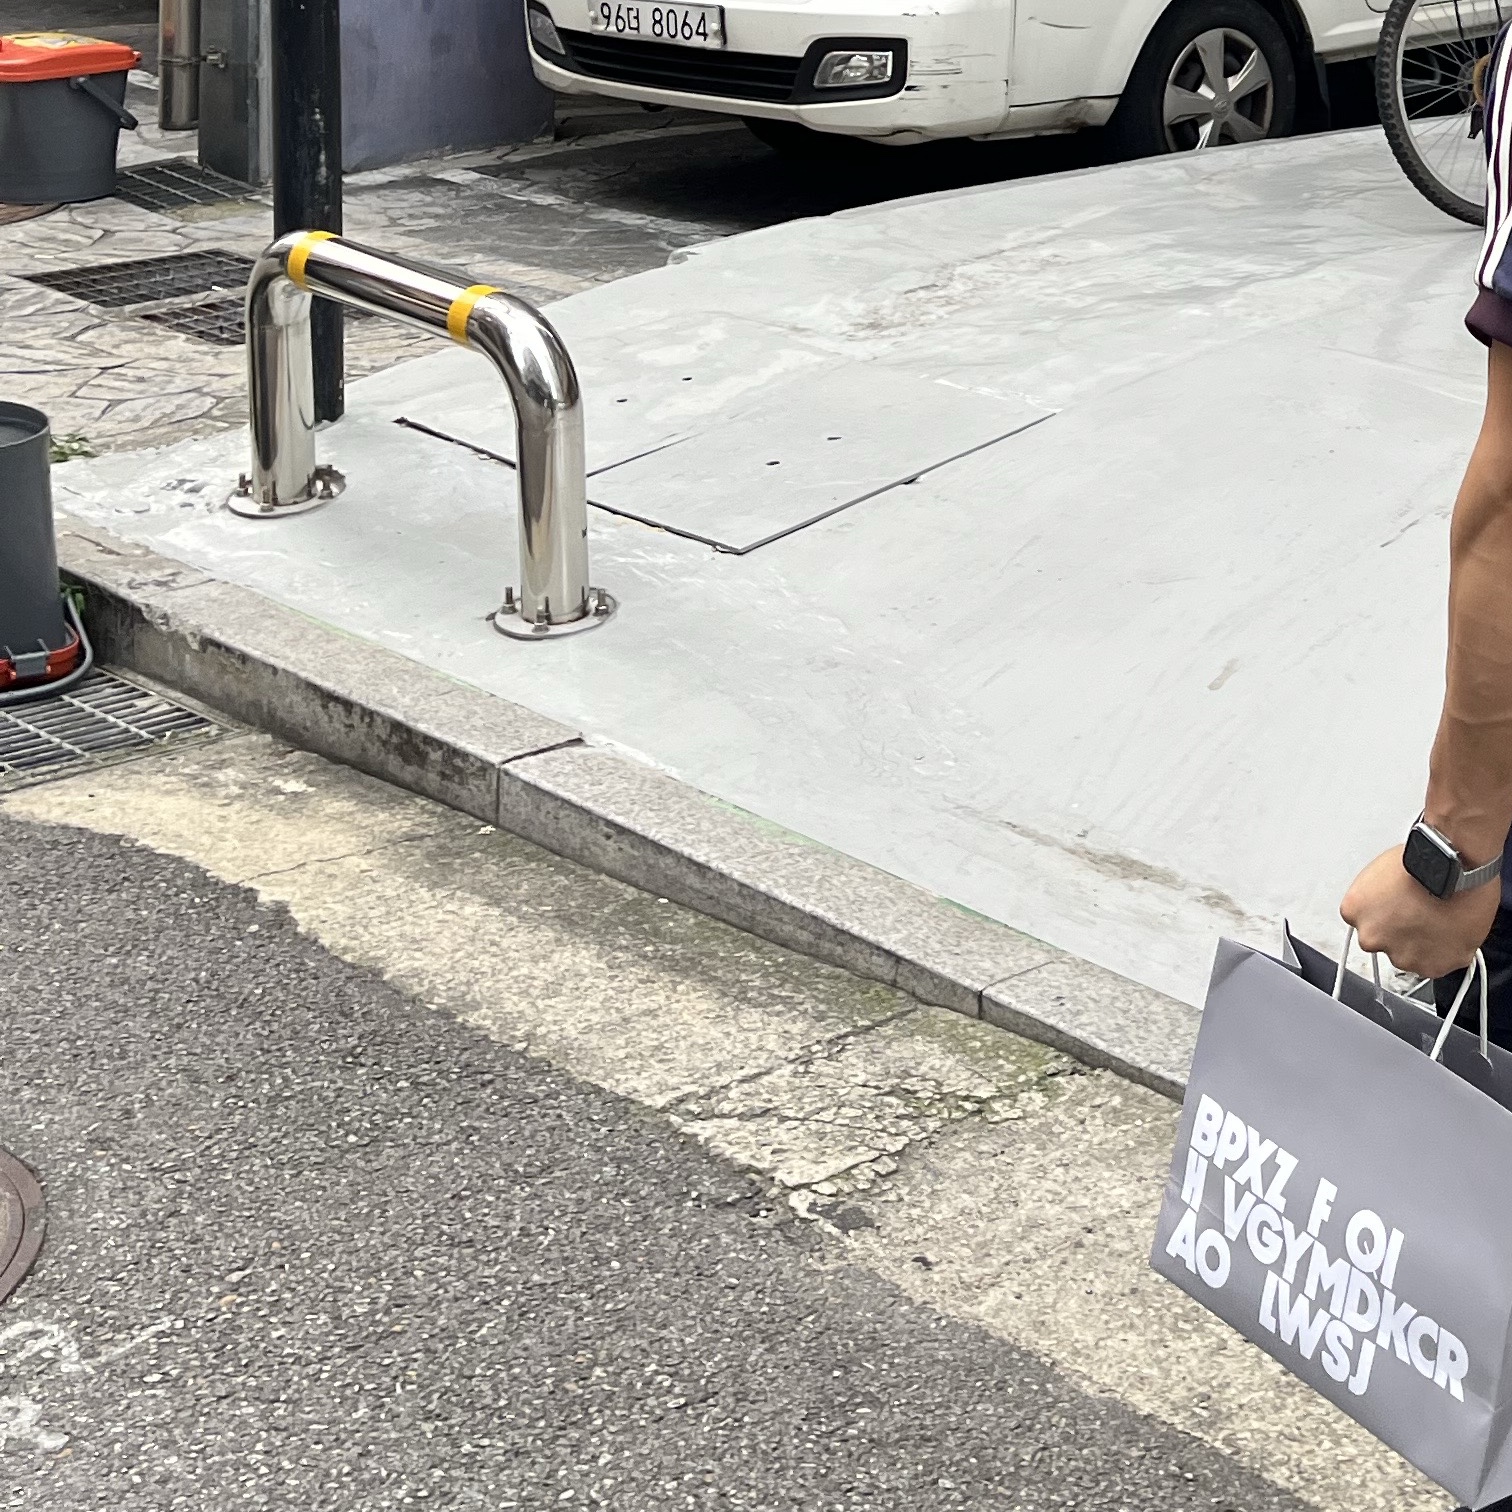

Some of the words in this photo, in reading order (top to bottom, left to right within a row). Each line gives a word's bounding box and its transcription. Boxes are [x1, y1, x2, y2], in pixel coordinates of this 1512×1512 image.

[600, 2, 640, 34] 96더
[651, 7, 709, 42] 8064
[1190, 1093, 1299, 1214] BPXZ
[1306, 1177, 1338, 1238] F
[1165, 1207, 1231, 1289] AO
[1258, 1269, 1376, 1396] LWSJ
[1181, 1147, 1208, 1213] H
[1224, 1175, 1470, 1403] VGYMDKCR
